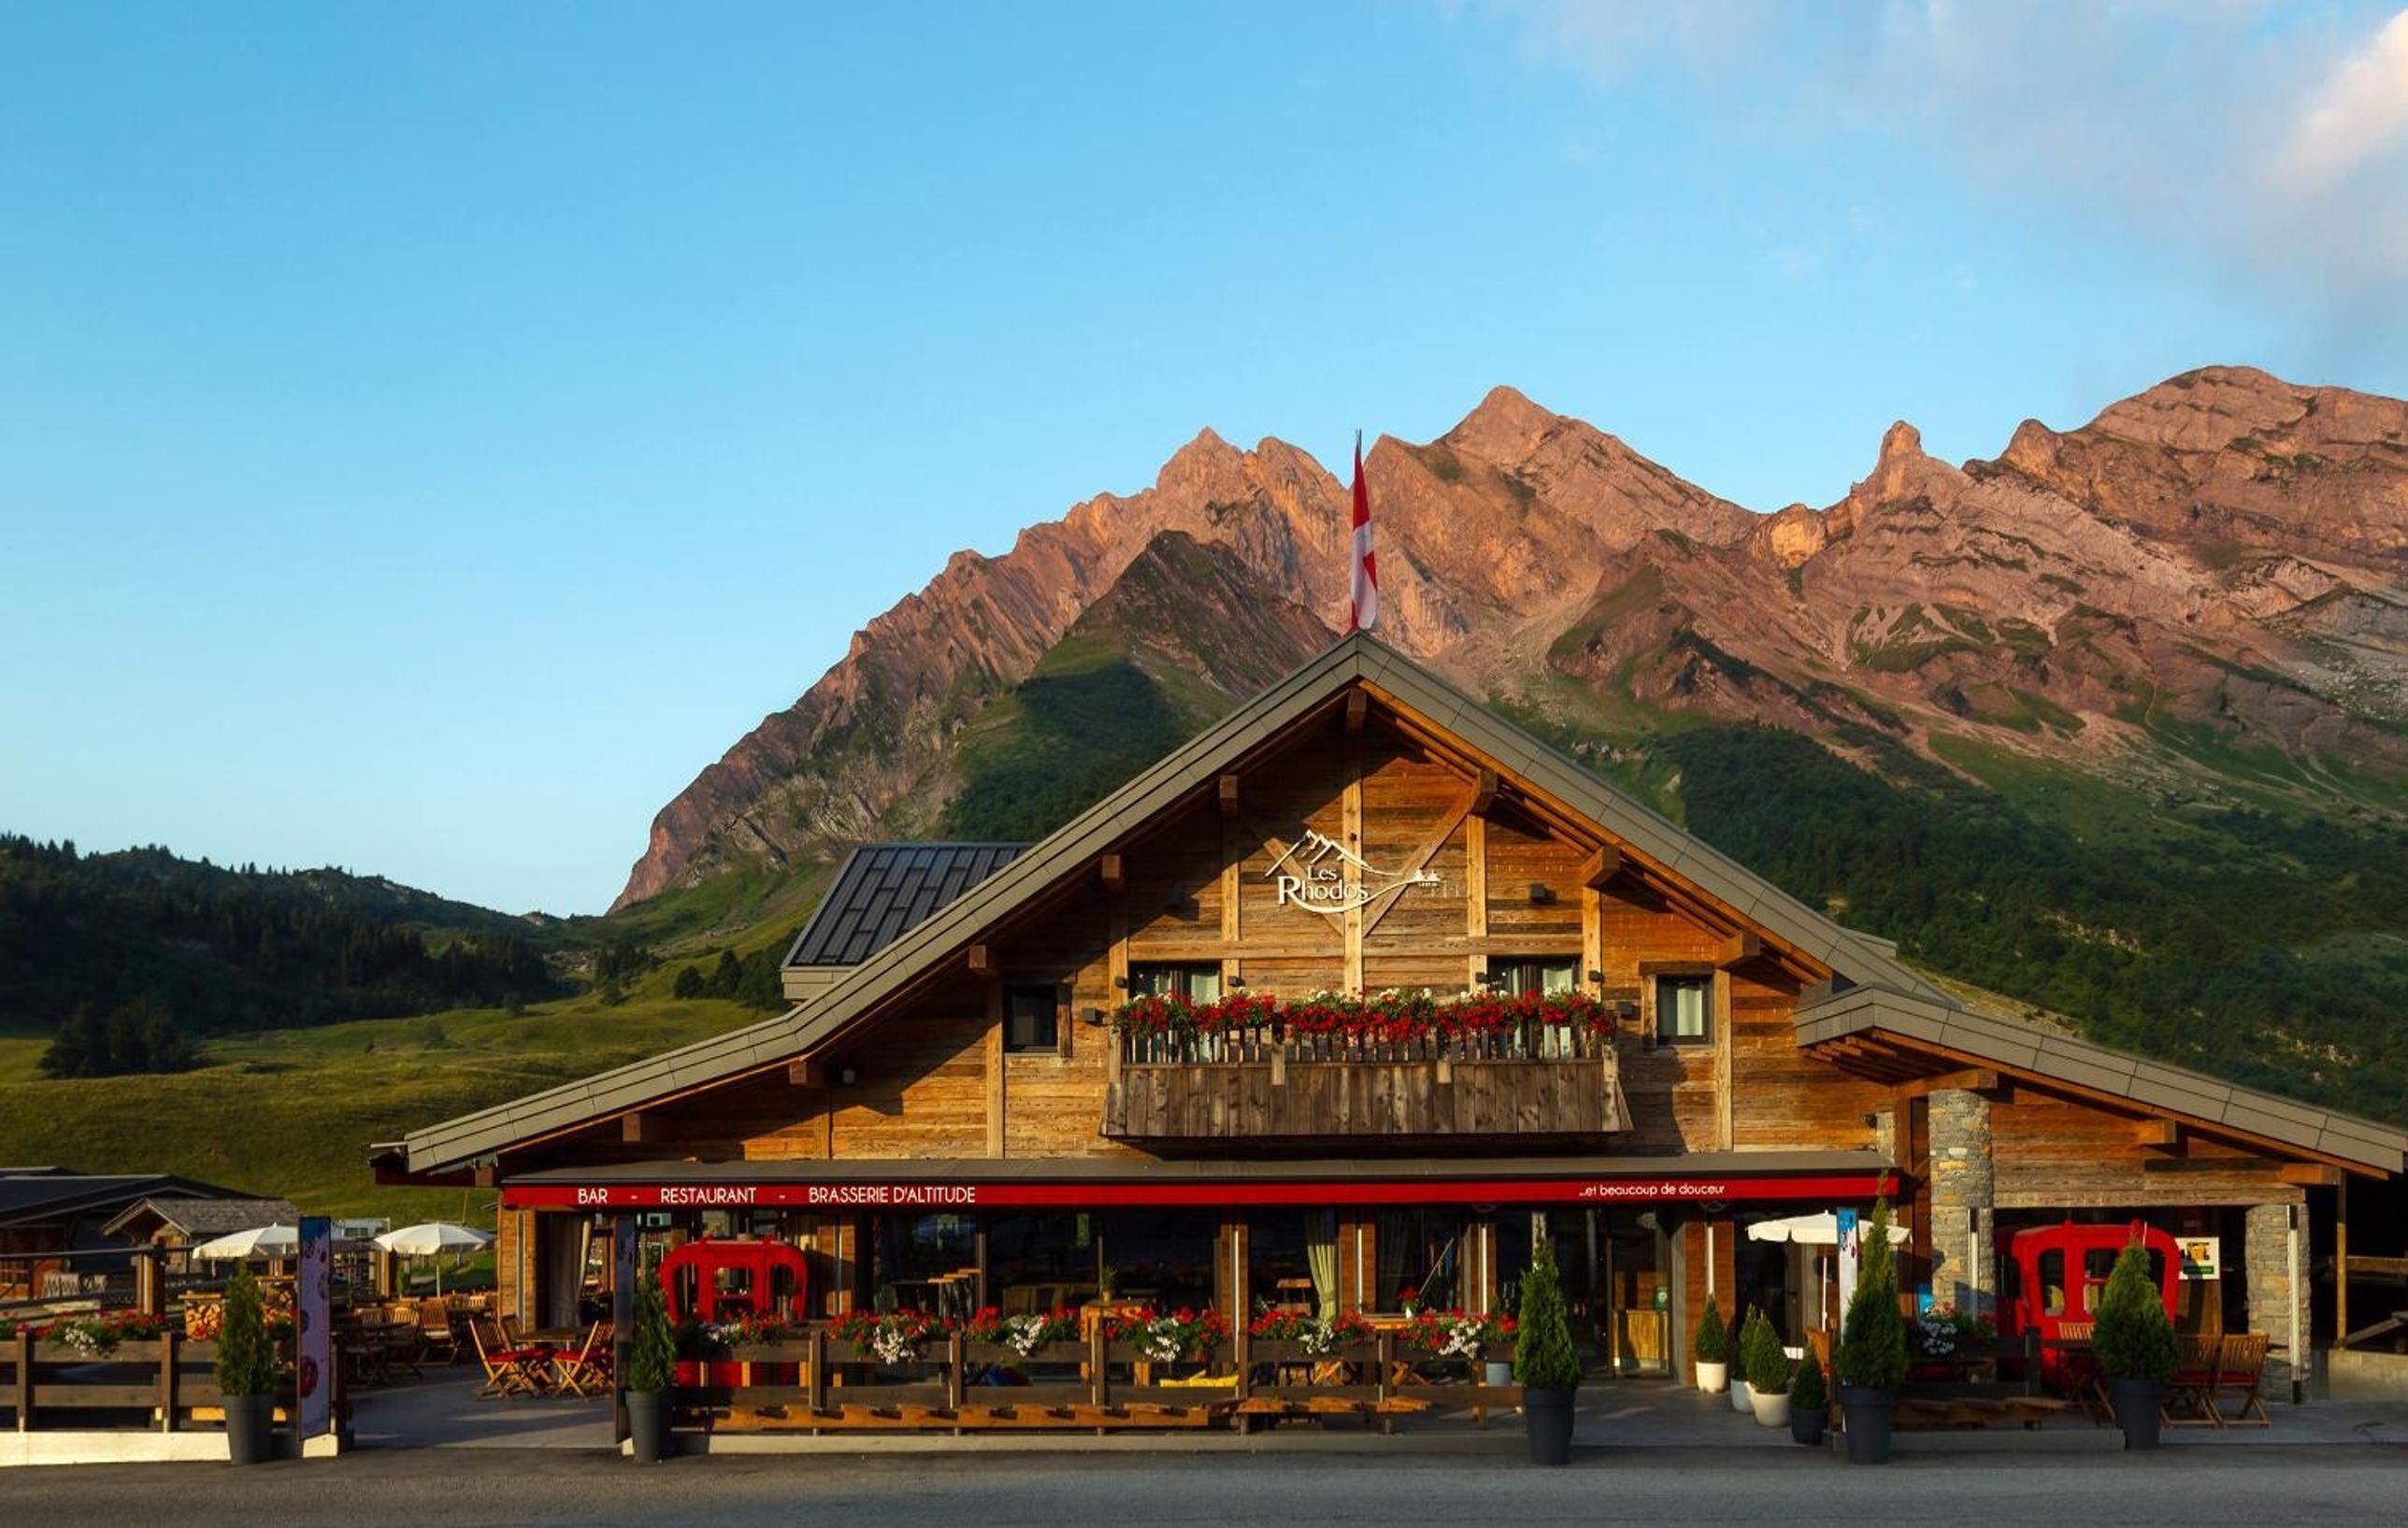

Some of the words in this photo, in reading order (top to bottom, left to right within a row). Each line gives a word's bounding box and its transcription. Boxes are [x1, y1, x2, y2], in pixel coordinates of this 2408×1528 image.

[1308, 866, 1337, 880] Les
[1278, 876, 1369, 905] Rhodos
[578, 1188, 608, 1204] BAR
[660, 1187, 756, 1204] RESTAURANT
[809, 1187, 888, 1203] BRASSERIE
[894, 1187, 975, 1203] D'ALTITUDE
[1600, 1184, 1657, 1197] beaucoup
[1660, 1182, 1676, 1195] de
[1679, 1183, 1725, 1194] douceur
